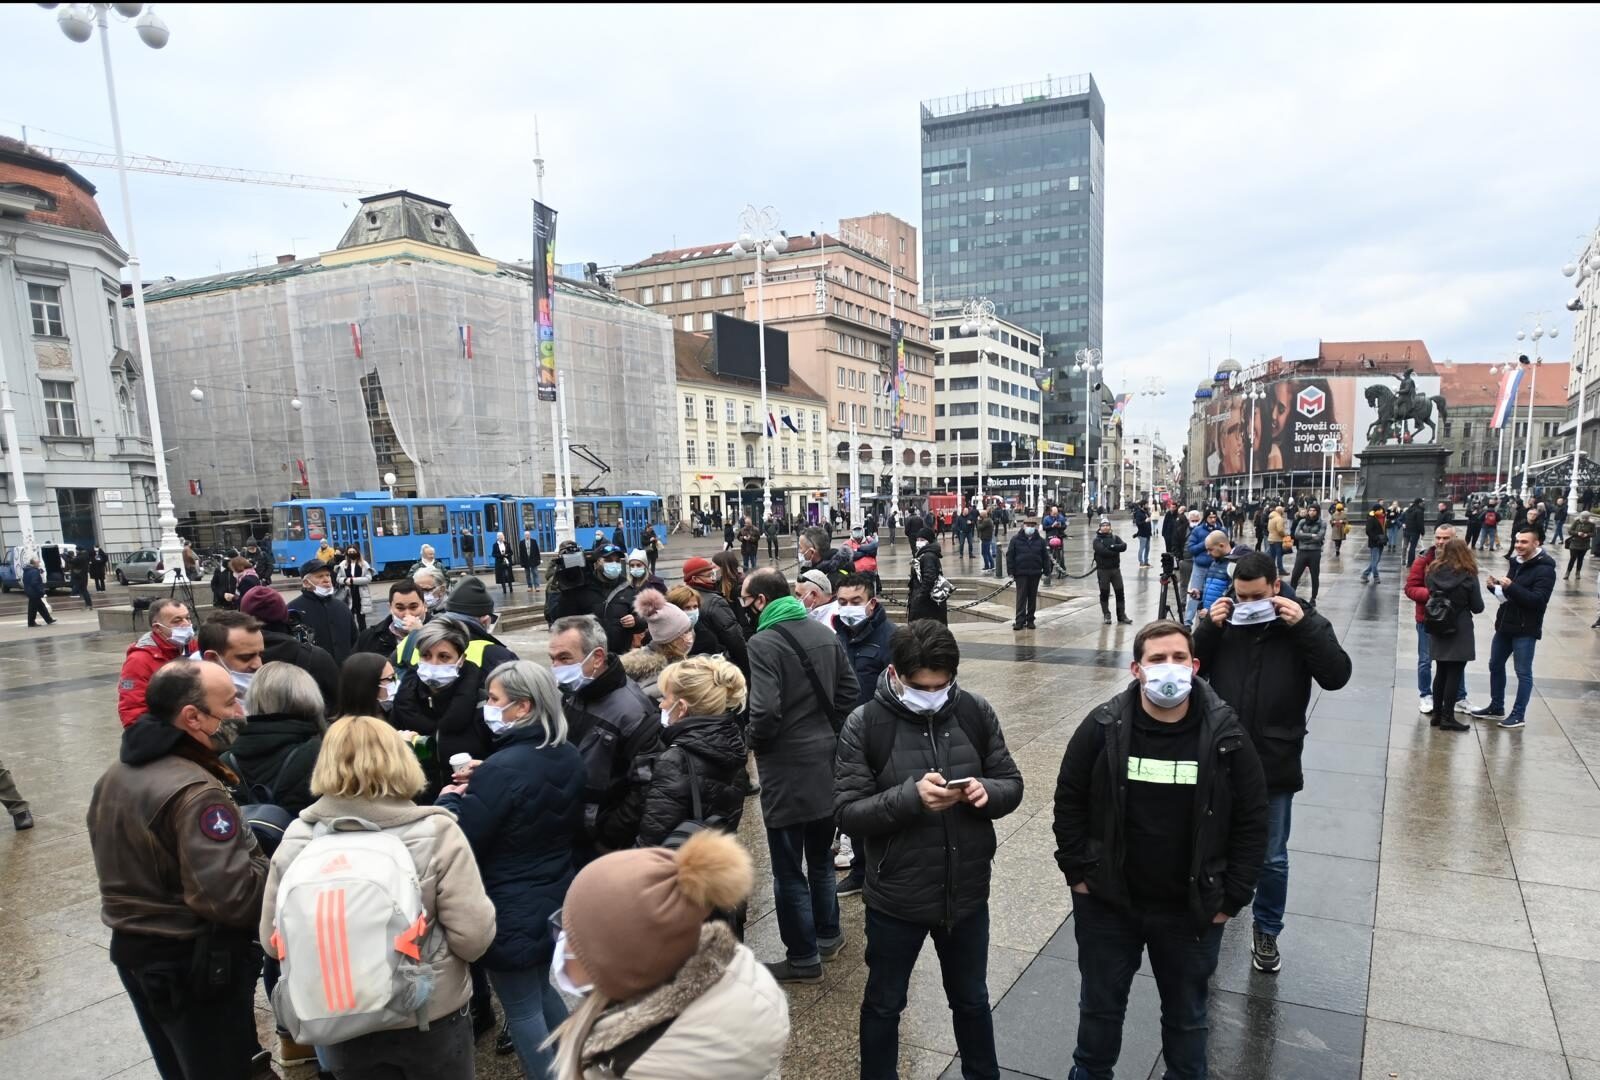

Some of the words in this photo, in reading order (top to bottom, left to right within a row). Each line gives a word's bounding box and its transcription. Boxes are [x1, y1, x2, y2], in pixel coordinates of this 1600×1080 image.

[1295, 421, 1327, 431] Poveži
[1294, 432, 1316, 443] koje
[1294, 445, 1301, 453] u
